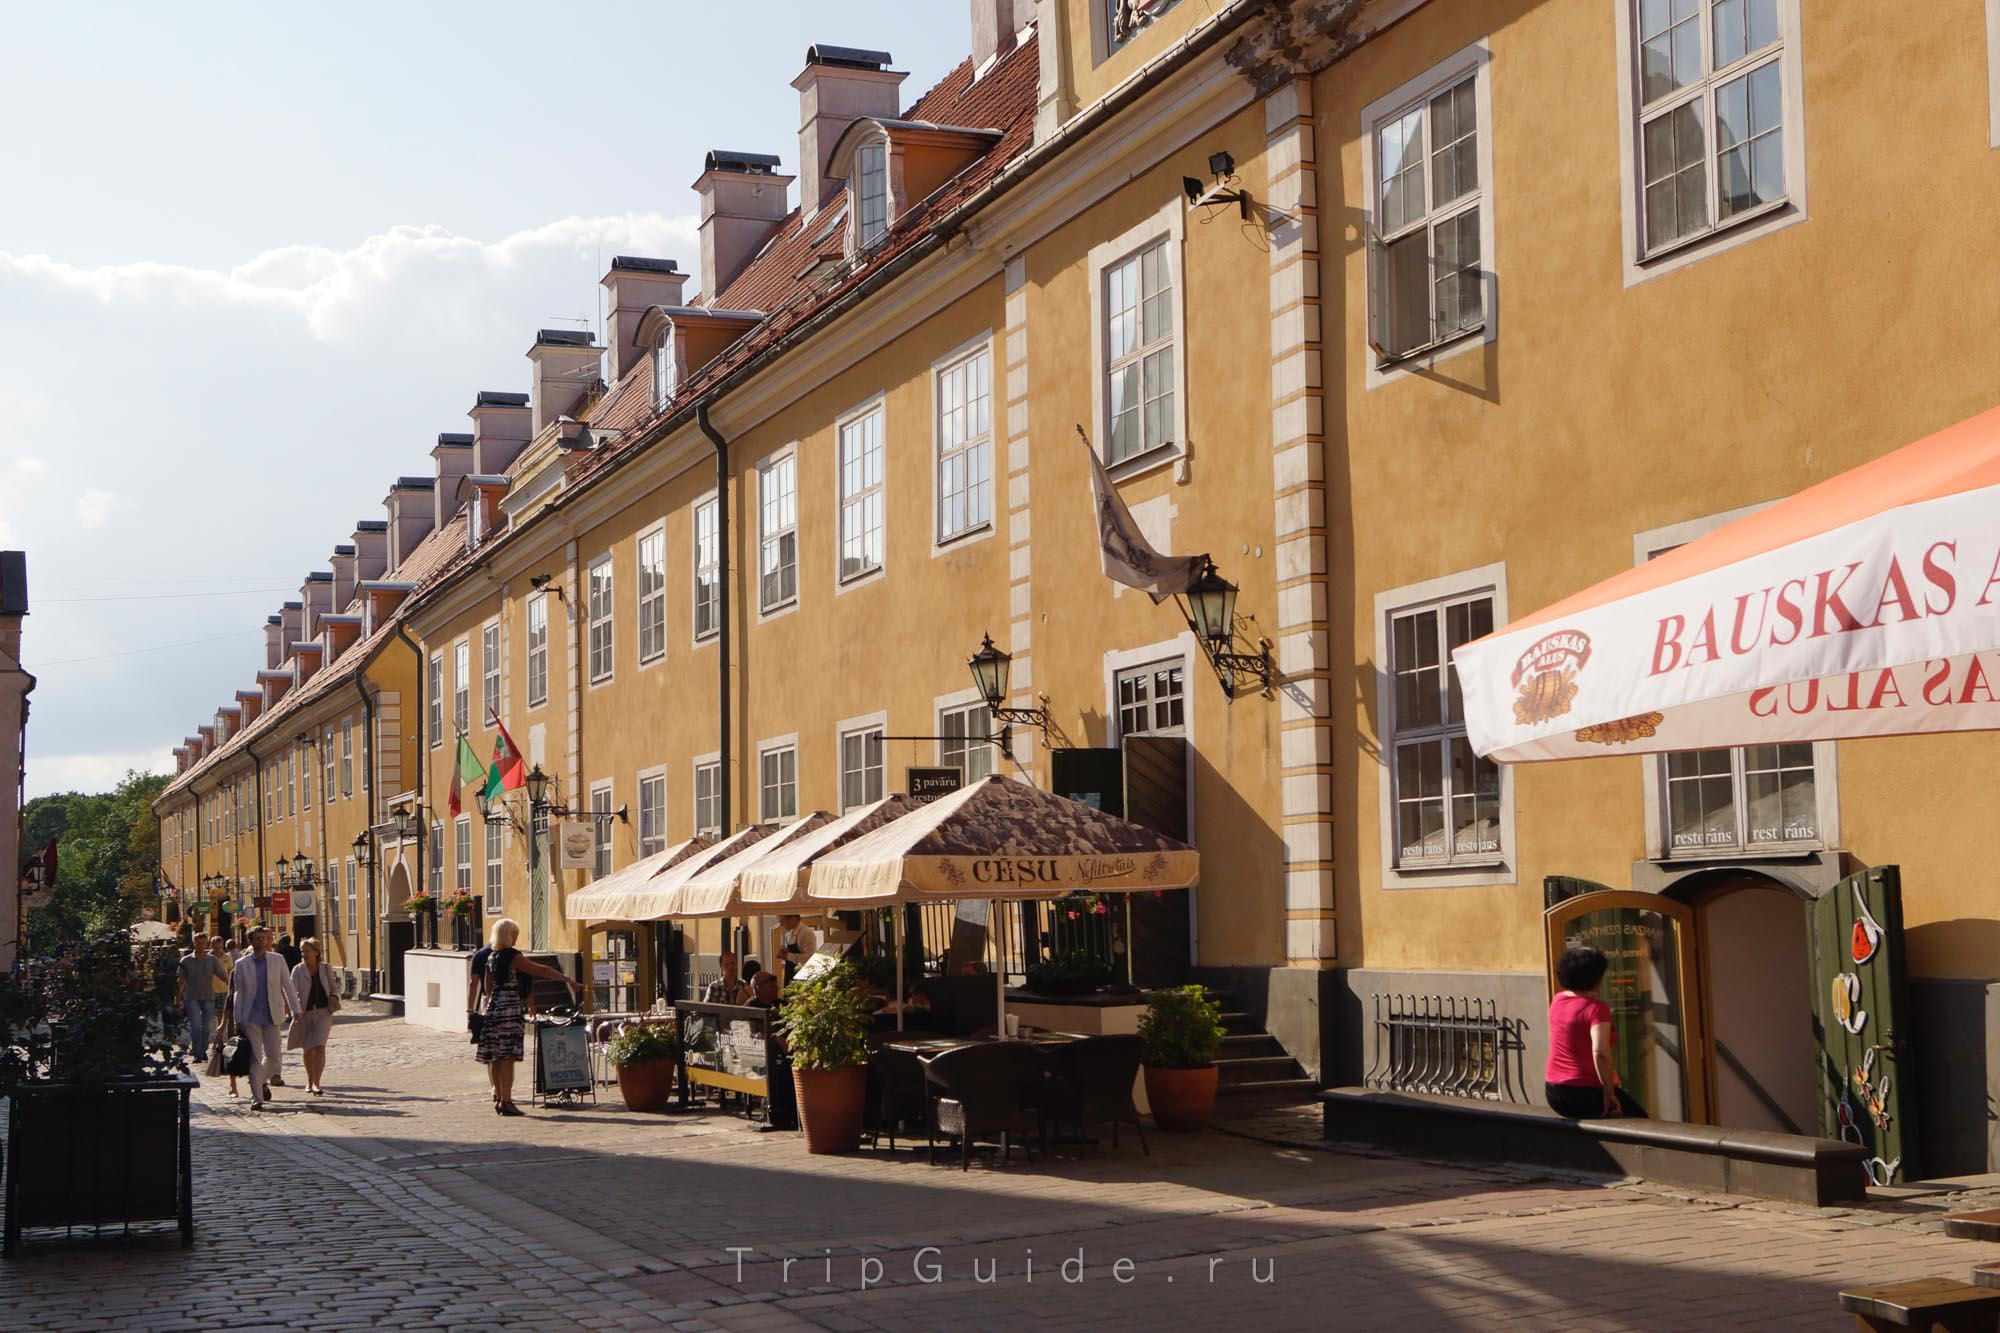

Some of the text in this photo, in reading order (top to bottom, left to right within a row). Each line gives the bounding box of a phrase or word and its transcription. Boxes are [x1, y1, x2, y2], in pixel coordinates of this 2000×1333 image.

[1647, 538, 1958, 678] BAUSKAS
[1521, 634, 1587, 670] BAUSKAS
[913, 776, 956, 792] 3 pavāru
[1752, 822, 1814, 840] restrāns
[972, 858, 1061, 887] CĒSU
